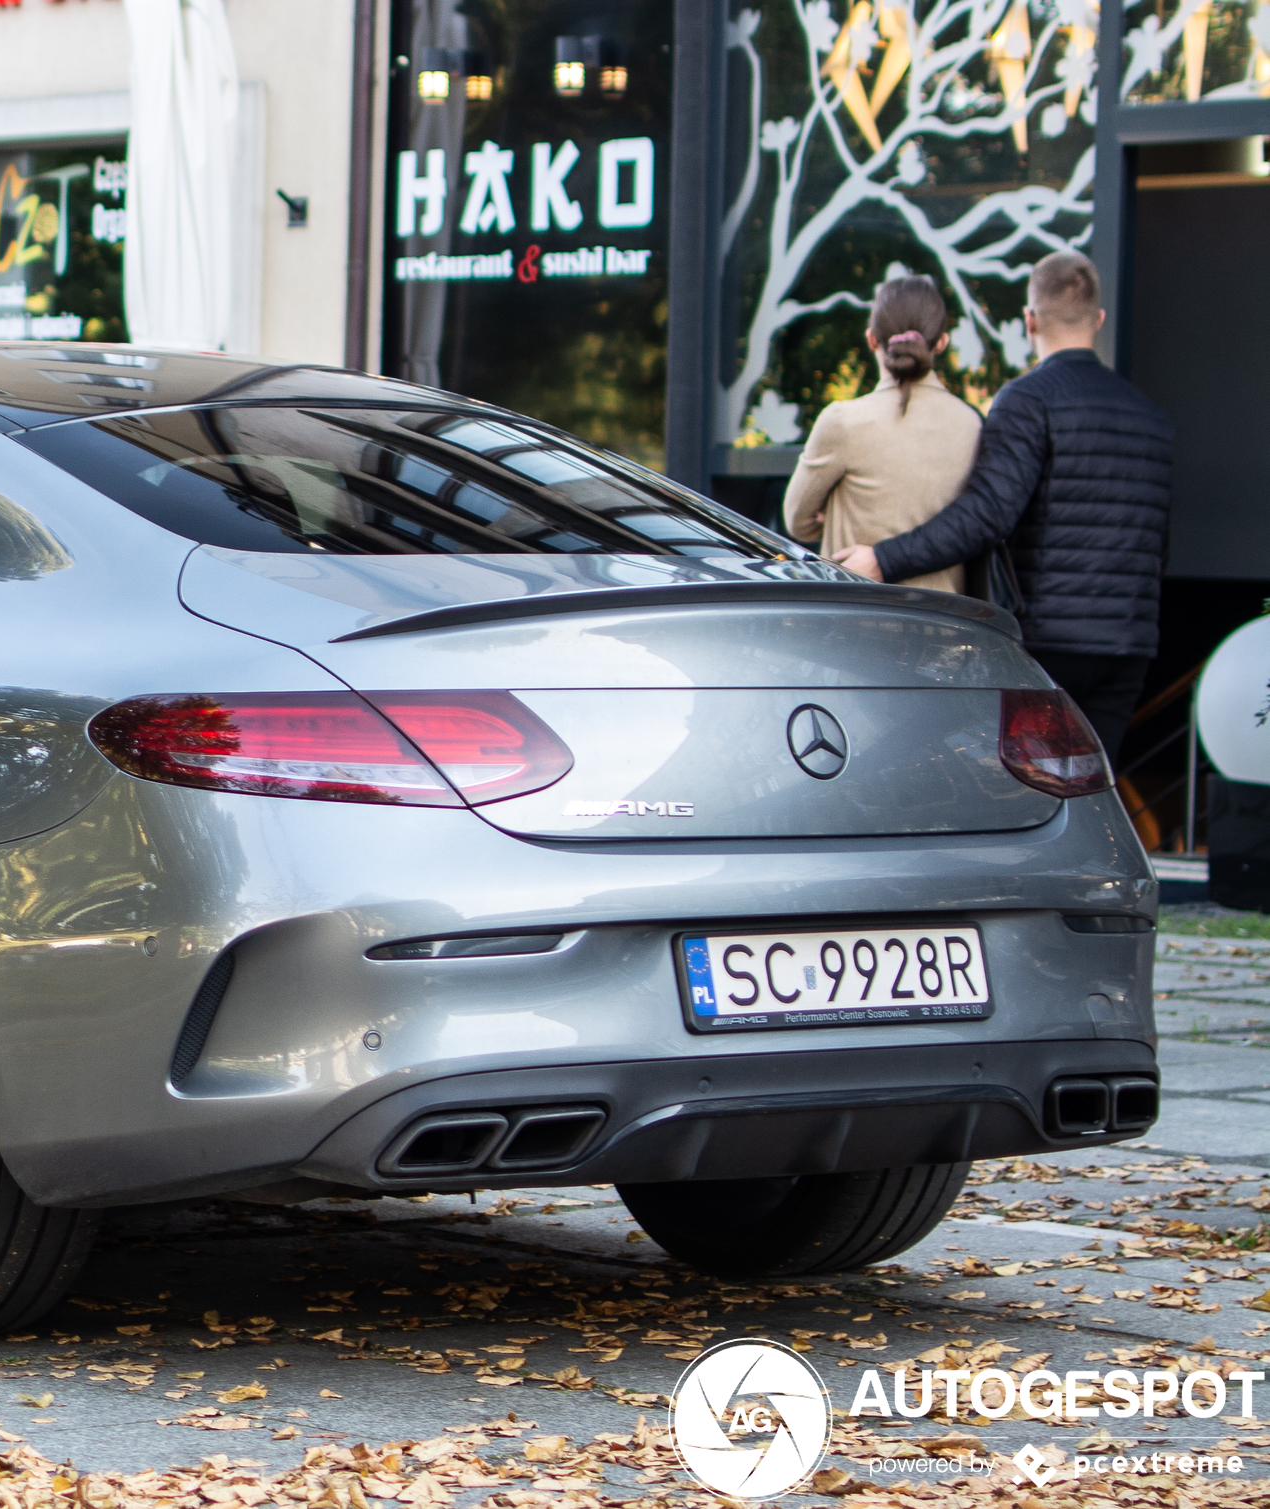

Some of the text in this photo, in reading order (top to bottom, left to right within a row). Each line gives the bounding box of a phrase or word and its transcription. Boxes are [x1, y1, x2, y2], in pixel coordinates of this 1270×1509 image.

[397, 136, 655, 238] HAKO
[396, 245, 652, 283] restaurant & sushi bar
[606, 799, 695, 818] AMG
[723, 936, 979, 1007] SC 9928R
[693, 985, 714, 1004] PL
[728, 1004, 984, 1025] AMG Performance Center Sosnowiec 32 368 45 00
